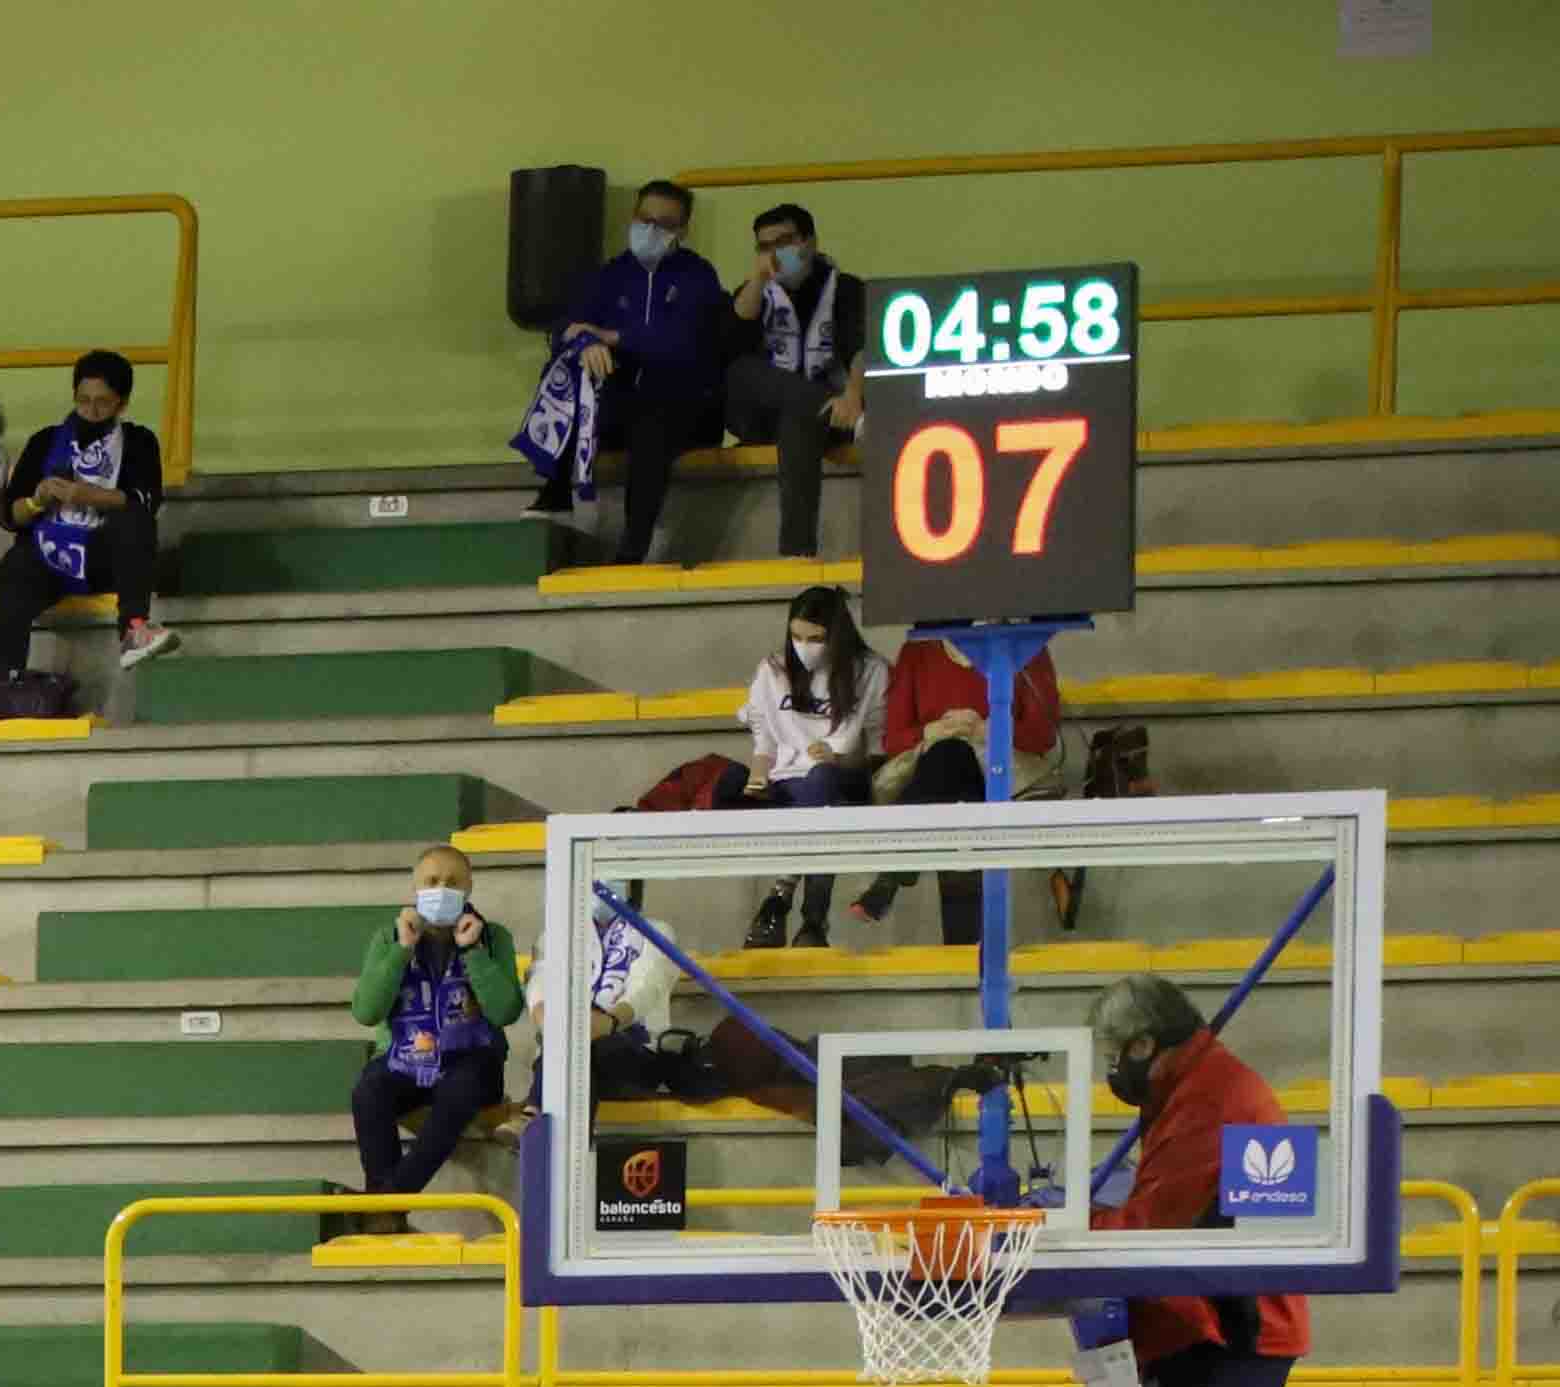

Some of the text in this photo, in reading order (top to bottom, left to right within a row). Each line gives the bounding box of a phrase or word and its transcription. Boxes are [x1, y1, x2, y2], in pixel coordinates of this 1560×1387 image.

[882, 280, 1120, 367] 04:58
[892, 416, 1089, 565] 07
[599, 1200, 681, 1215] baloncesto
